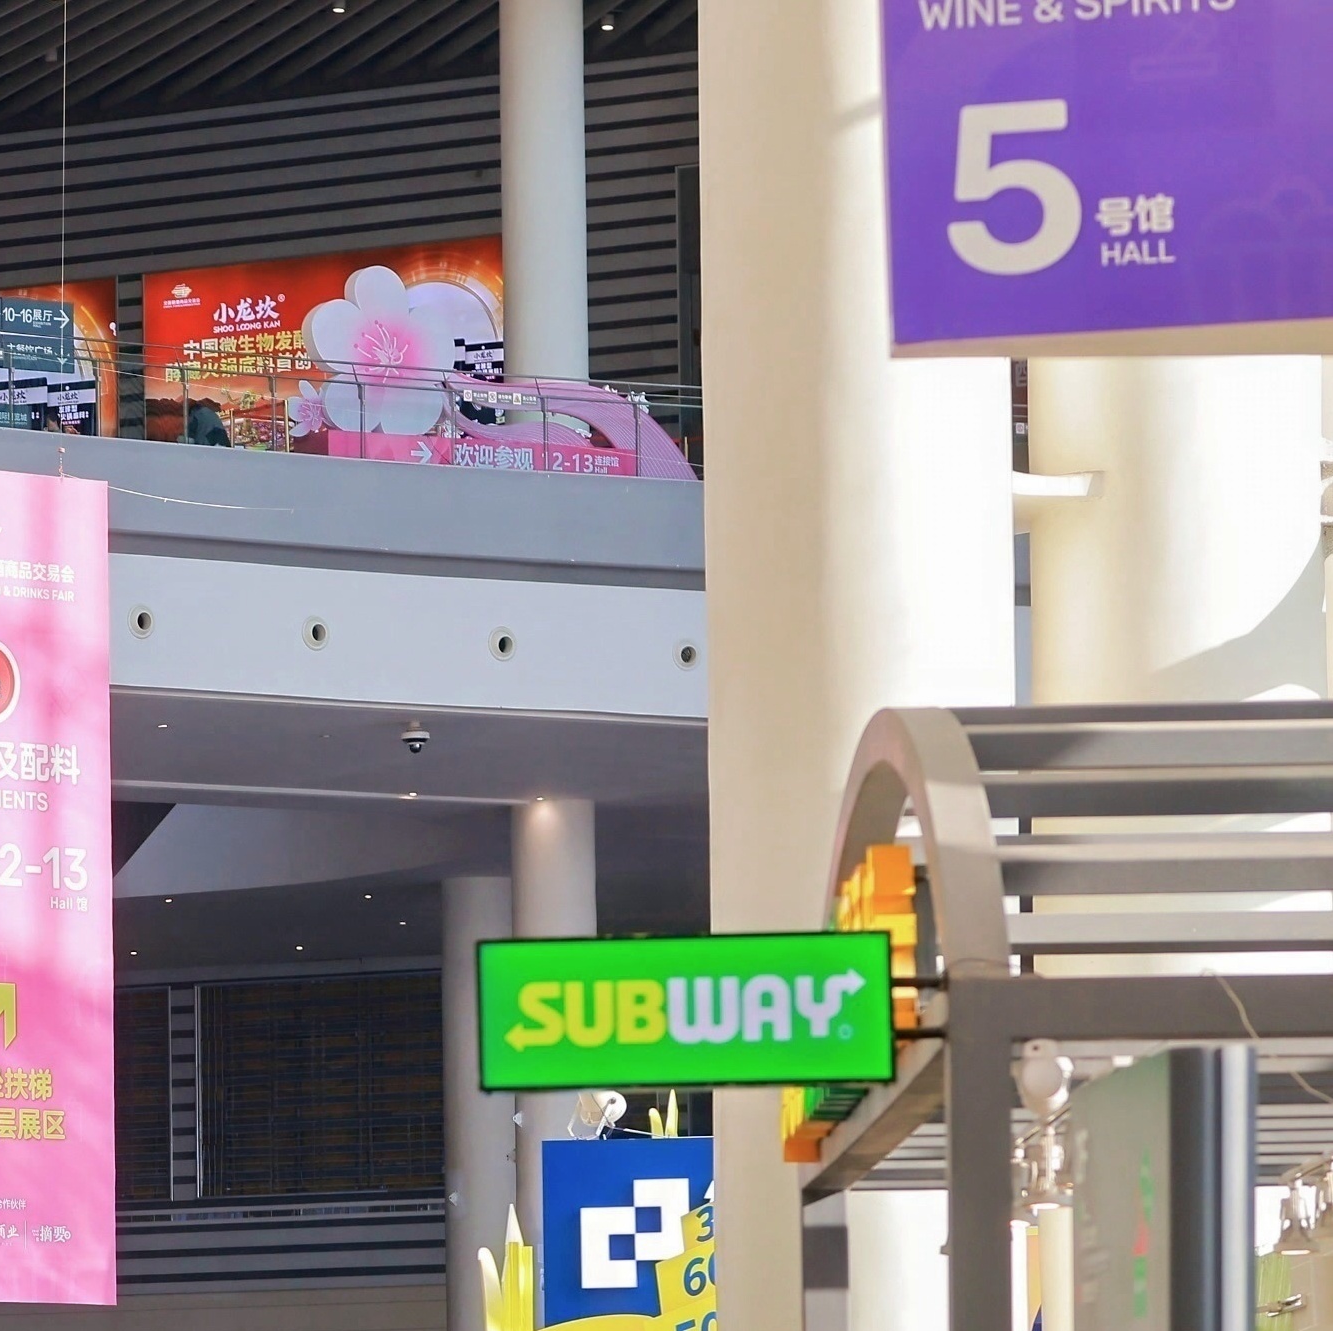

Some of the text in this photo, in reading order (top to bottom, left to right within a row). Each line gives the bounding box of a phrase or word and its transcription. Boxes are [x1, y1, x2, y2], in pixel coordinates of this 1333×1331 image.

[919, 0, 1023, 31] WINE
[947, 98, 1176, 276] 5 号馆
[1100, 239, 1176, 267] HALL
[2, 307, 33, 324] 10-16
[33, 309, 53, 322] 展厅
[213, 294, 280, 325] 小龙坎
[213, 319, 281, 334] SHOO LOONG KAN
[454, 443, 535, 471] 欢迎参观
[3, 584, 11, 597] &
[12, 586, 50, 600] DRINKS
[51, 589, 75, 602] FAIR
[49, 895, 74, 911] Hall
[76, 896, 89, 913] 馆
[504, 968, 867, 1052] SUBWAY
